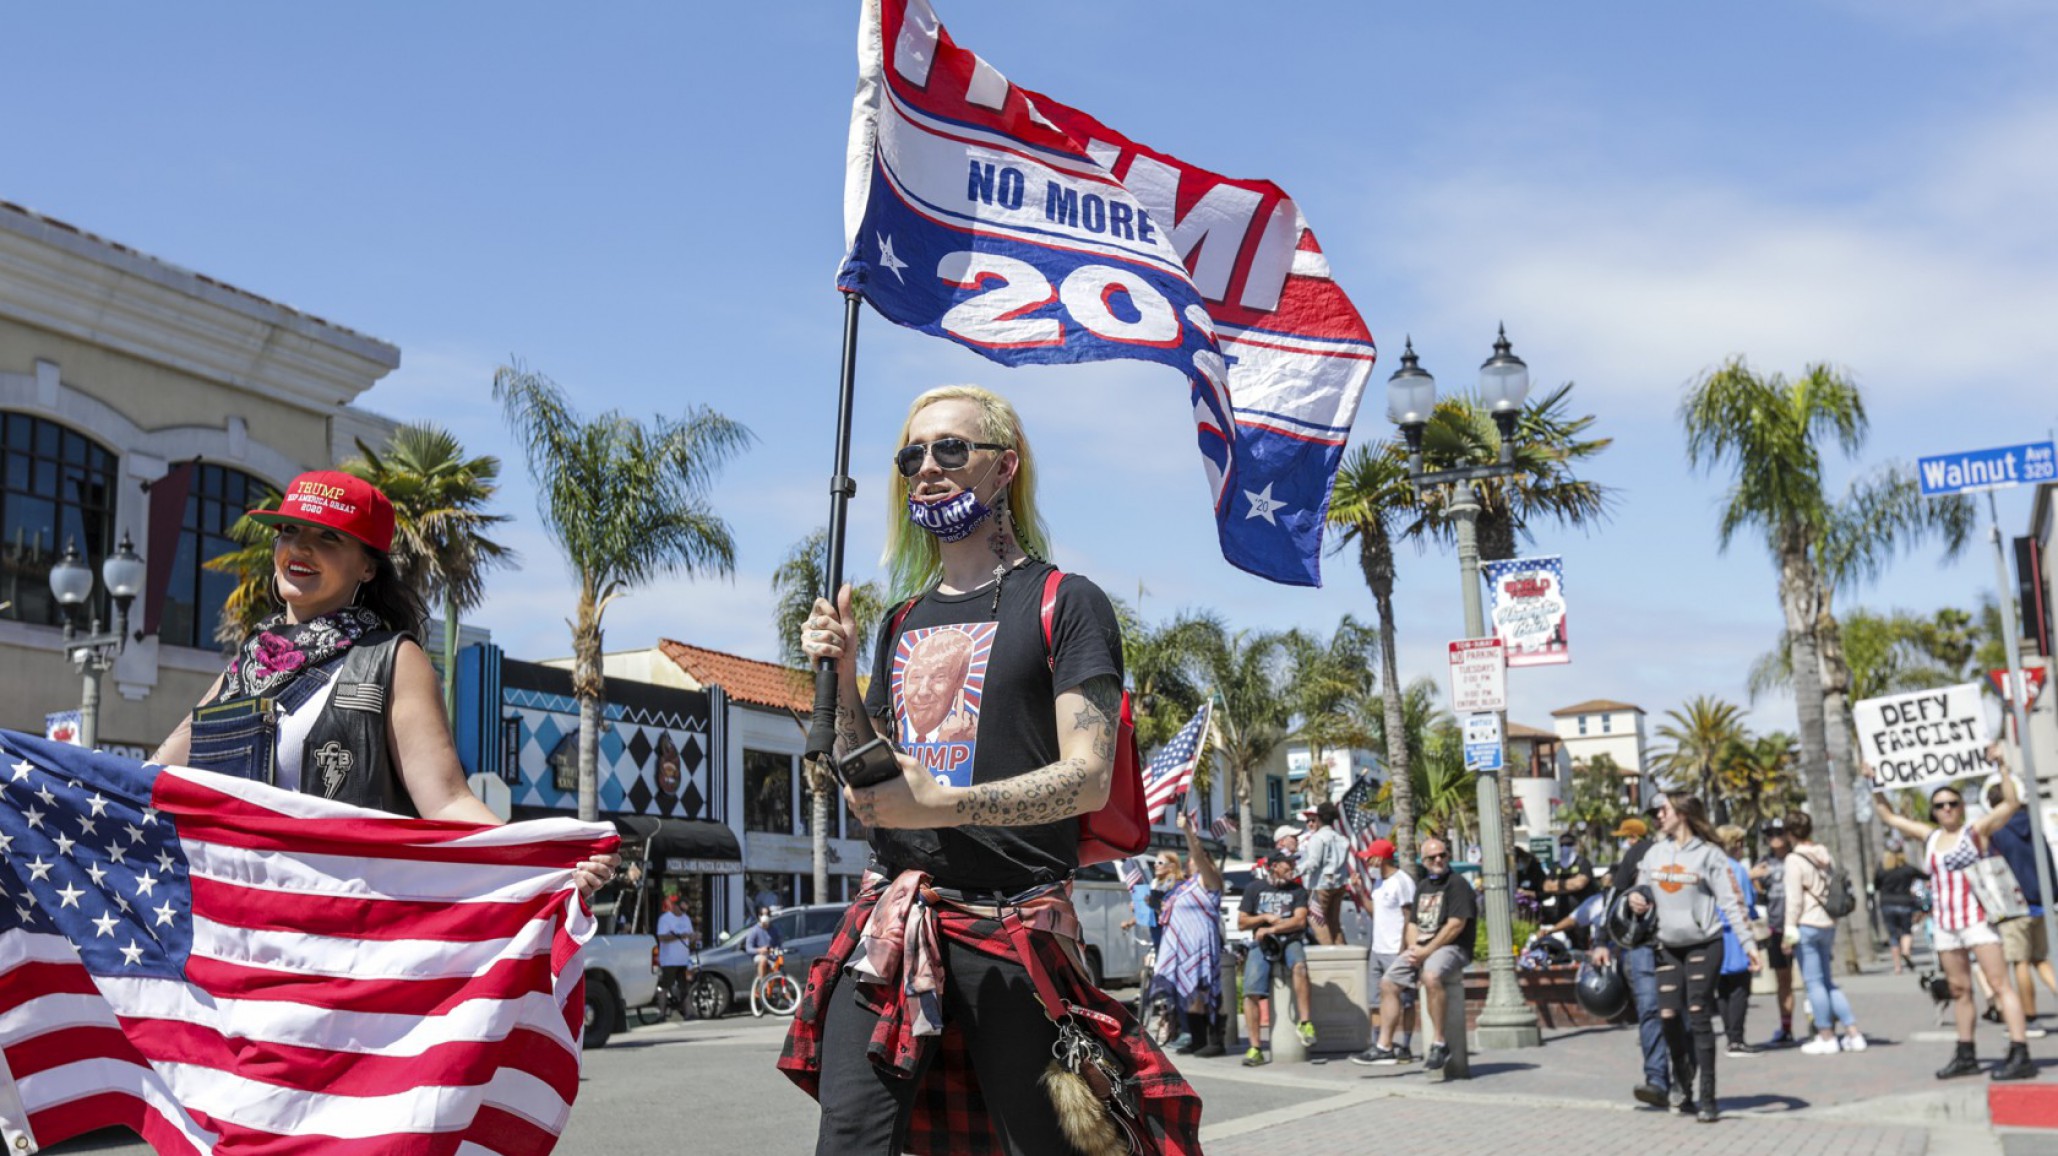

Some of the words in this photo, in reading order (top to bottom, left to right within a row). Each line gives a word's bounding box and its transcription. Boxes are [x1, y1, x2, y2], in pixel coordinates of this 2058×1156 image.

[967, 159, 1024, 211] NO
[1044, 179, 1157, 245] MORE
[1922, 452, 2018, 490] Walnut
[2025, 446, 2052, 461] Ave
[2024, 461, 2055, 480] 320
[298, 481, 345, 500] TRUMP
[298, 494, 328, 507] AMERICA
[329, 500, 357, 514] GREAT
[300, 503, 323, 515] 2020
[1466, 649, 1499, 660] PARKING
[1458, 663, 1496, 673] TUESDAYS
[1481, 698, 1501, 706] BLOCK
[1880, 694, 1949, 727] DEFY
[1873, 717, 1977, 756] FASCIST
